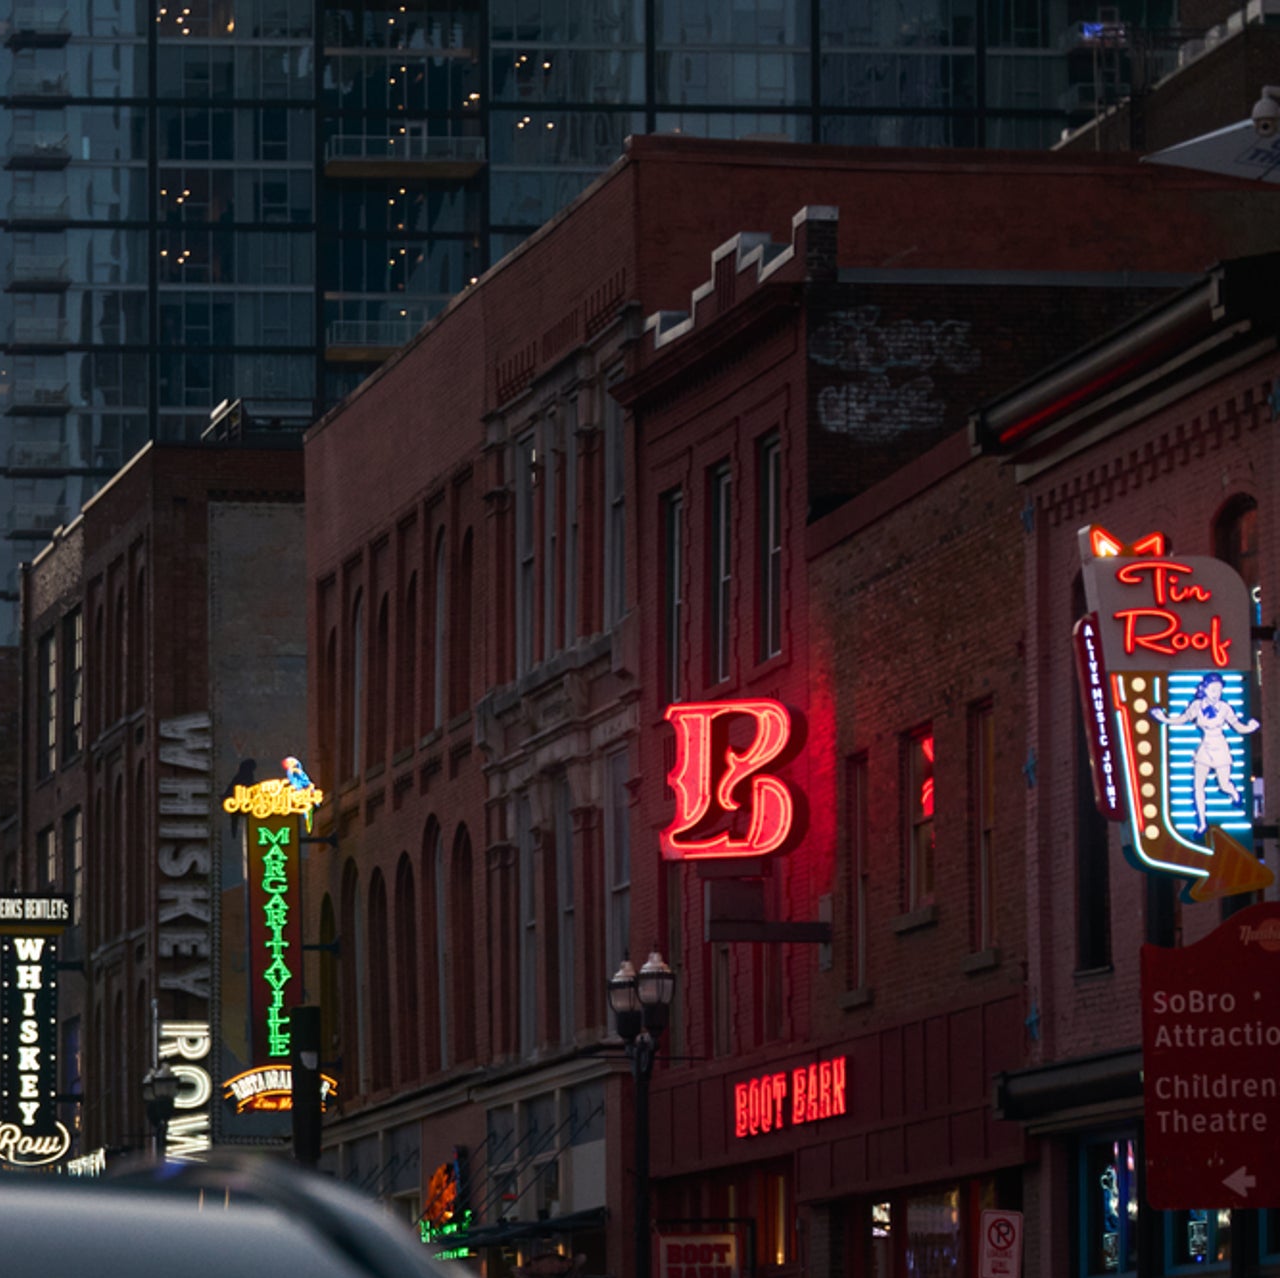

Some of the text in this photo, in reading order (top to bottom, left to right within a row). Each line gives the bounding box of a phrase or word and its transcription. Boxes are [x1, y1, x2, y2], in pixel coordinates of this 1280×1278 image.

[1116, 560, 1212, 606] Tin
[1113, 607, 1232, 667] Roof
[1091, 687, 1109, 747] MUSIC
[1102, 750, 1117, 810] JOINT
[158, 712, 212, 999] WHISKEY
[256, 826, 293, 1057] MARGARITAVILLE
[1151, 989, 1237, 1015] SoBro
[12, 938, 46, 1126] WHISKEY
[1154, 1021, 1280, 1049] Attractio
[734, 1054, 847, 1139] BOOT BARN
[1154, 1073, 1280, 1101] Children
[1156, 1107, 1269, 1135] Theatre
[666, 1243, 731, 1264] BOOT
